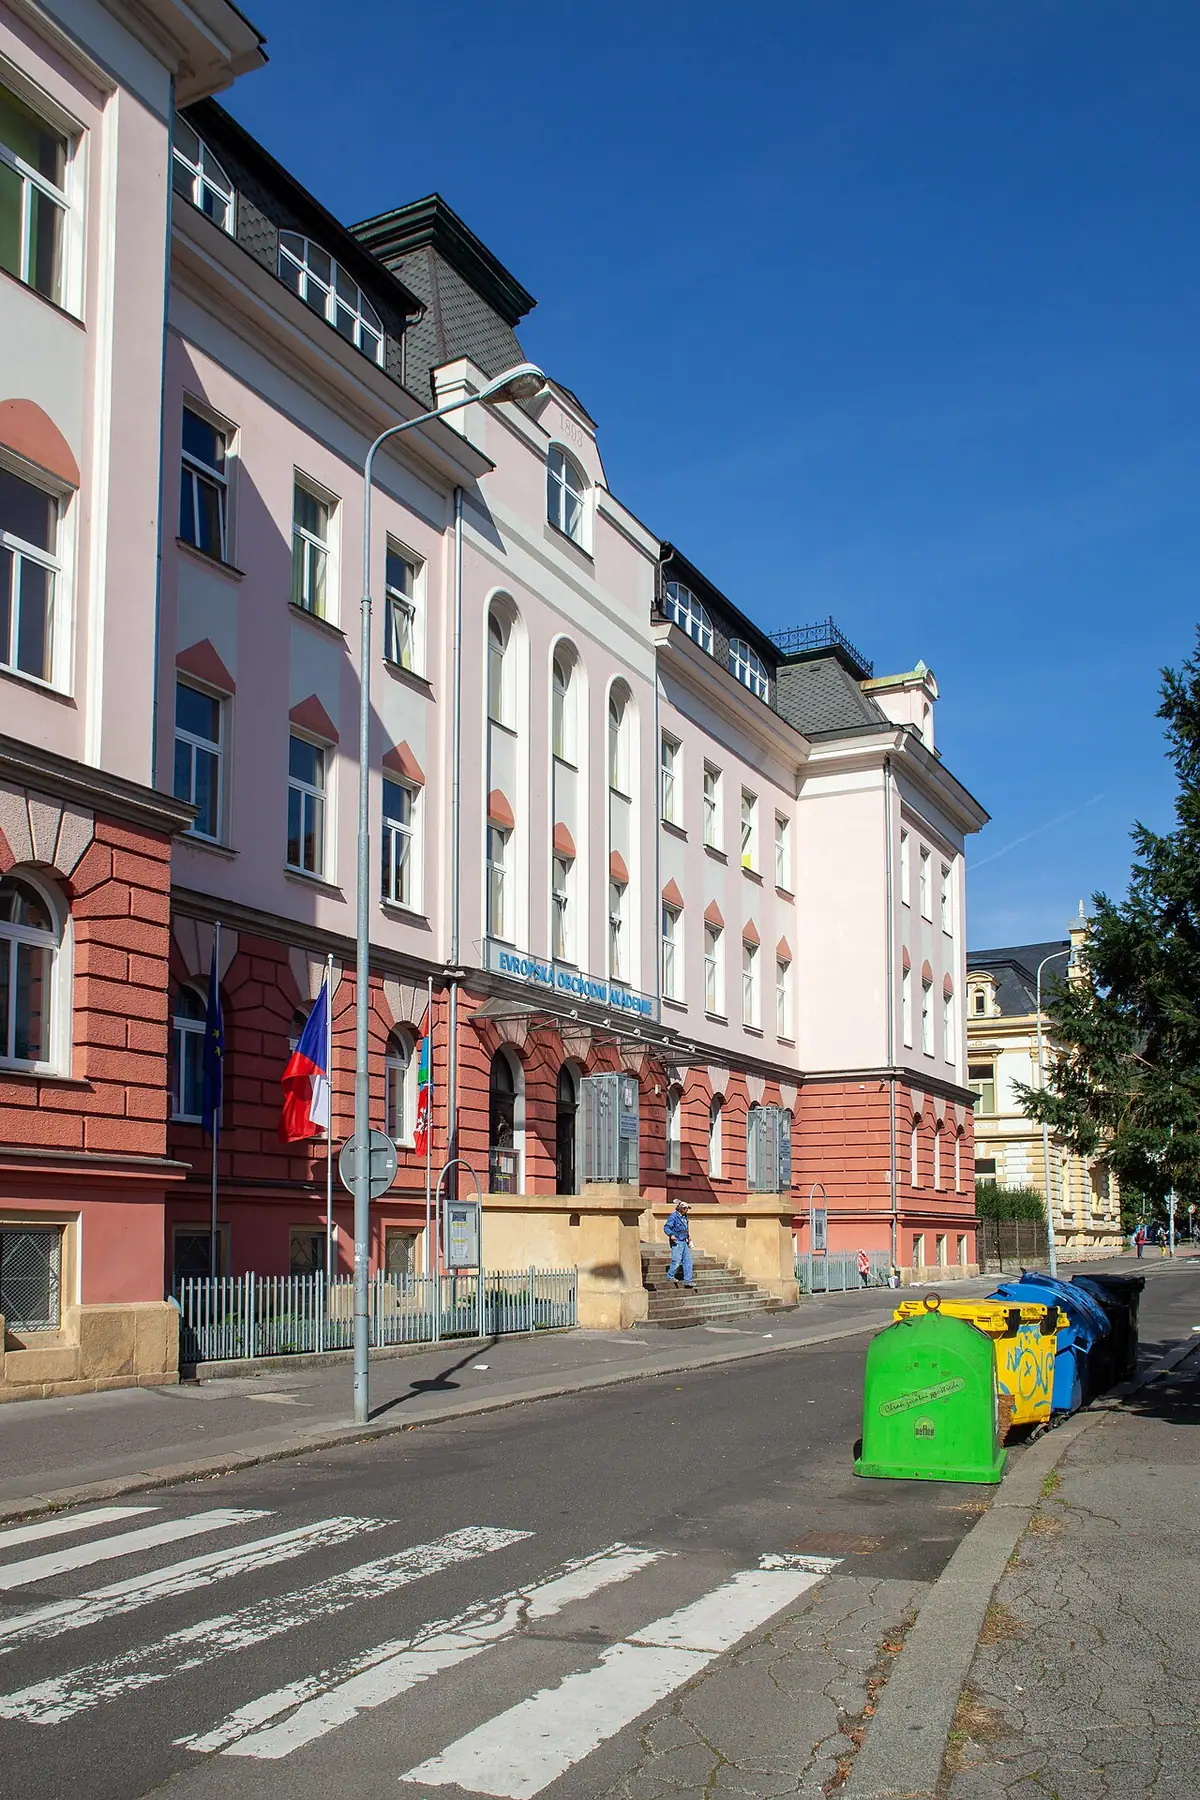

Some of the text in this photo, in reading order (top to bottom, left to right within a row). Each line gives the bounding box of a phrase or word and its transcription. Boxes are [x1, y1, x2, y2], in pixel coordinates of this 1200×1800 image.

[499, 952, 652, 1015] EVROPSKÁ OBCHODNÍ AKADEMIE
